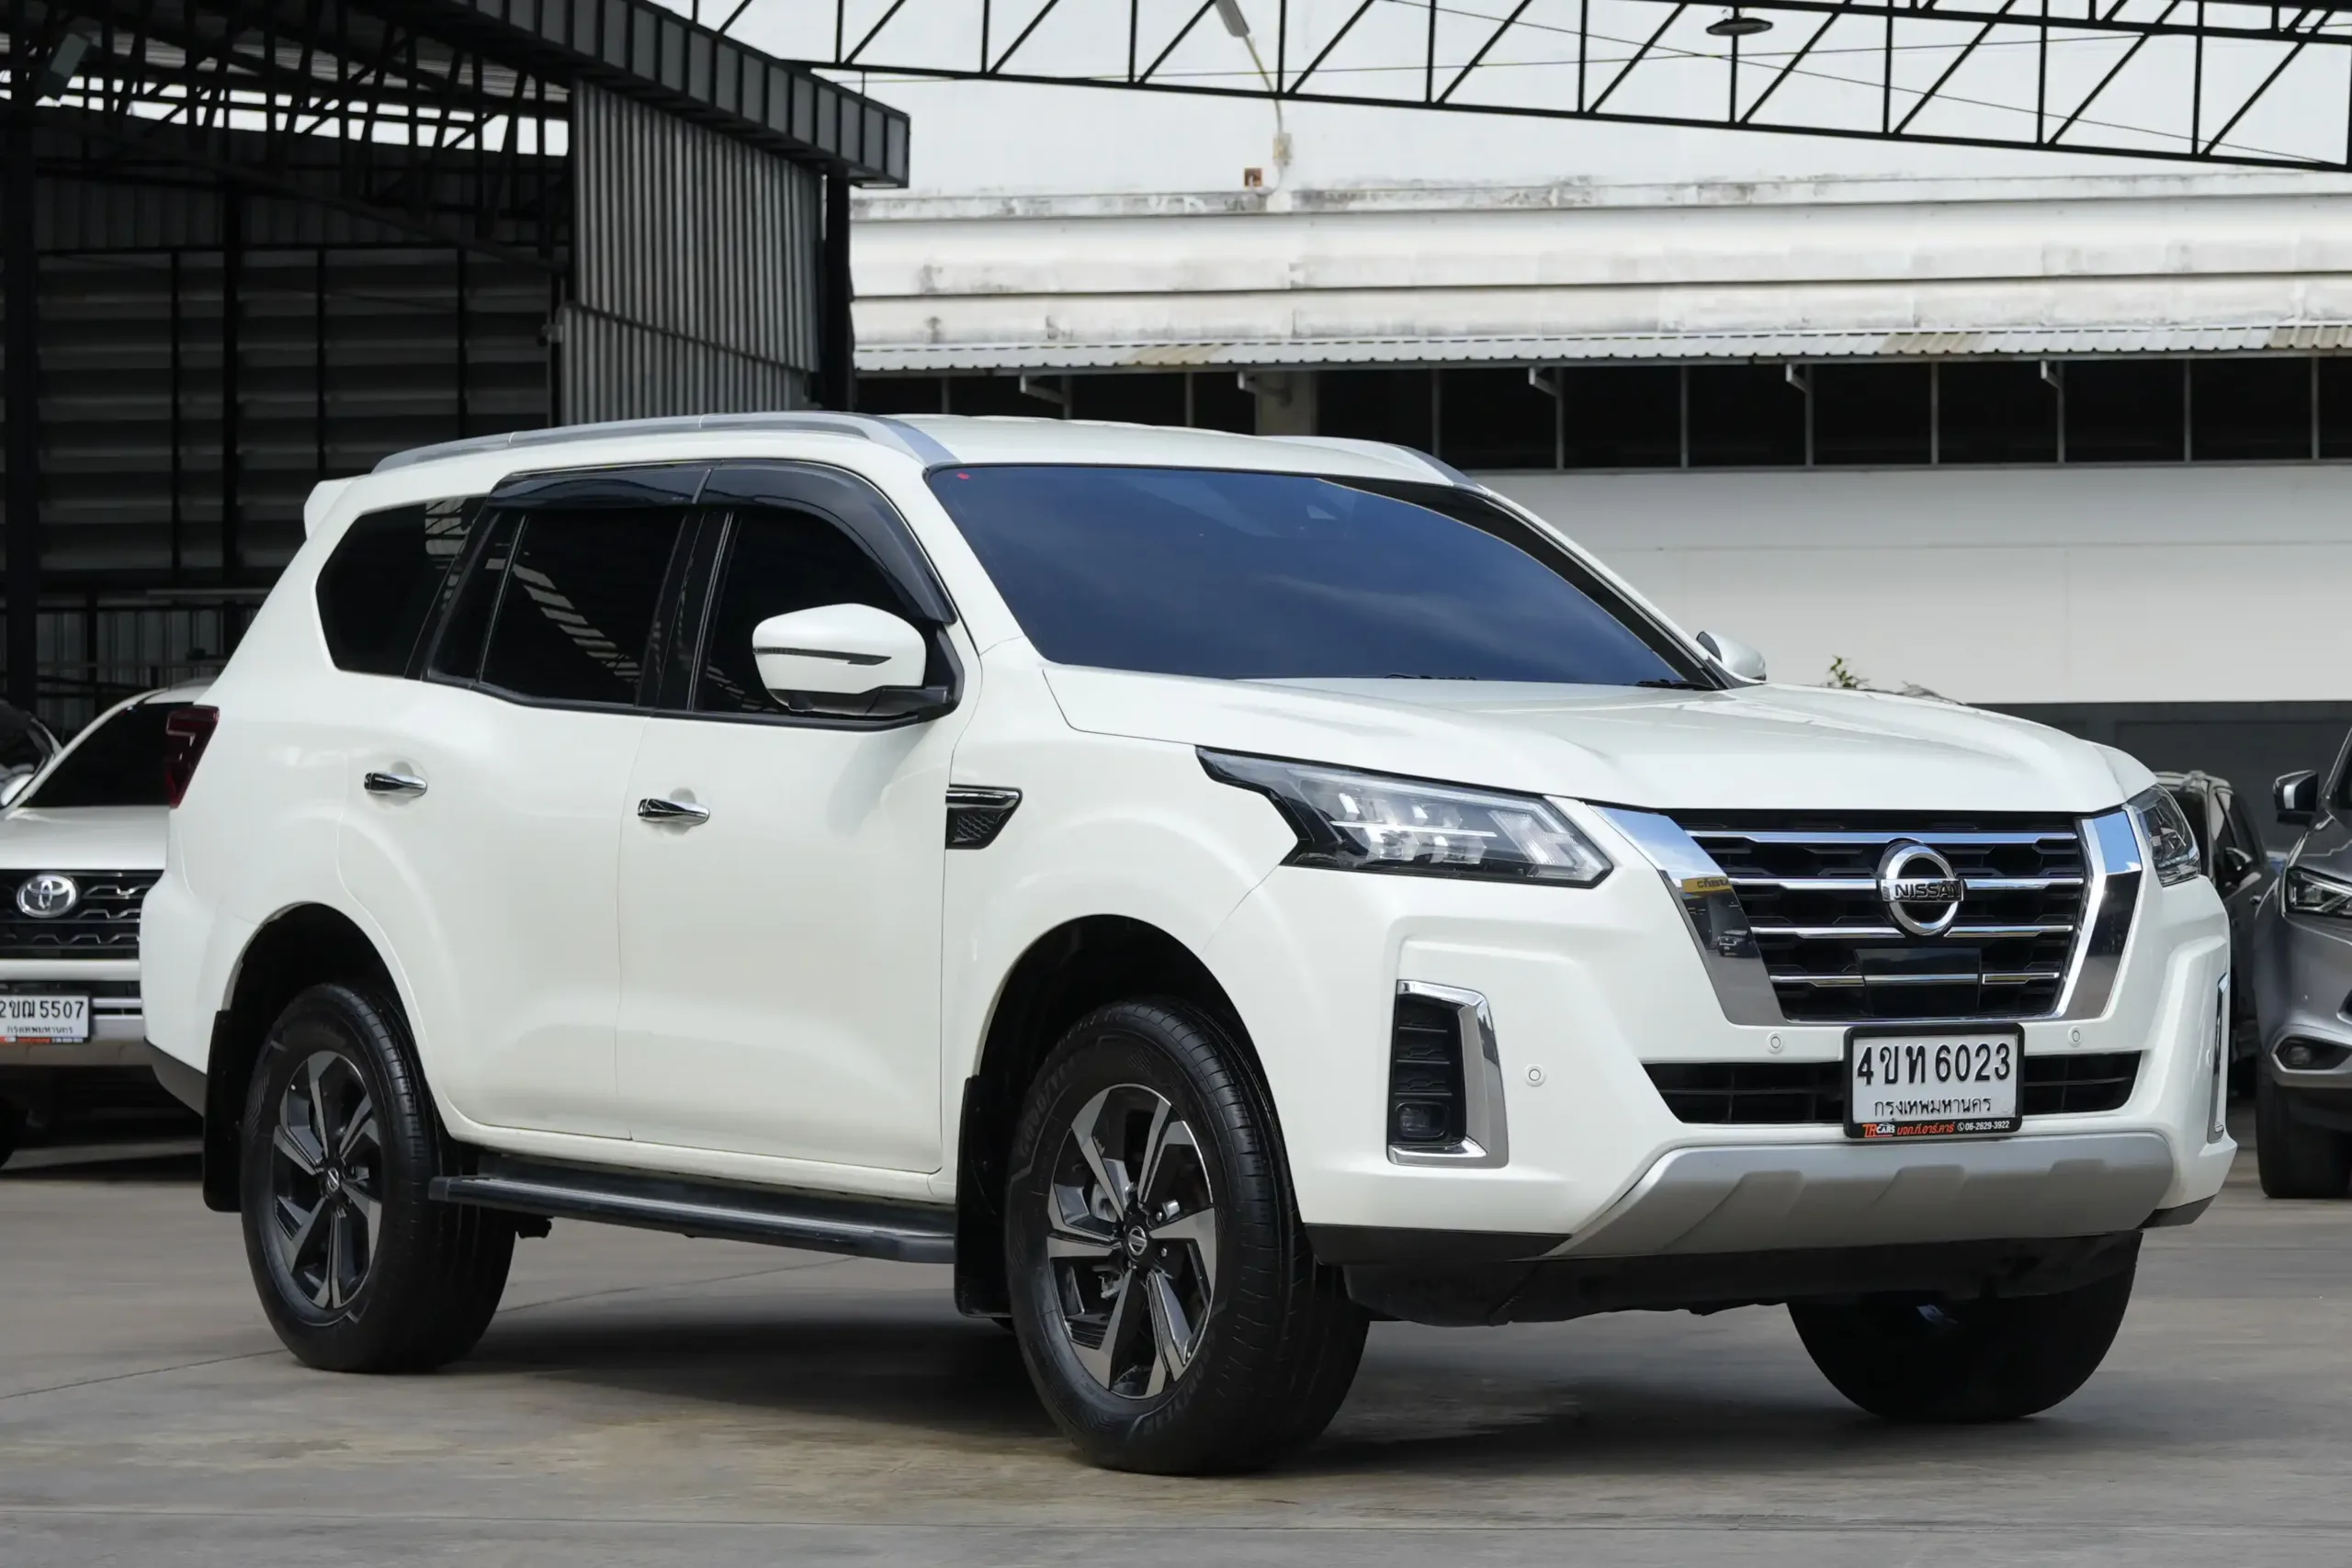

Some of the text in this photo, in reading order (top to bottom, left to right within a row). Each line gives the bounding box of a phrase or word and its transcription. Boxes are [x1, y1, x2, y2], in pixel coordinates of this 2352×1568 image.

[1894, 883, 1961, 898] NISSAN
[40, 999, 85, 1019] 5507
[1857, 1043, 2010, 1086] 4ขท 6023
[1874, 1098, 1992, 1117] กรุงเทพมหานคร
